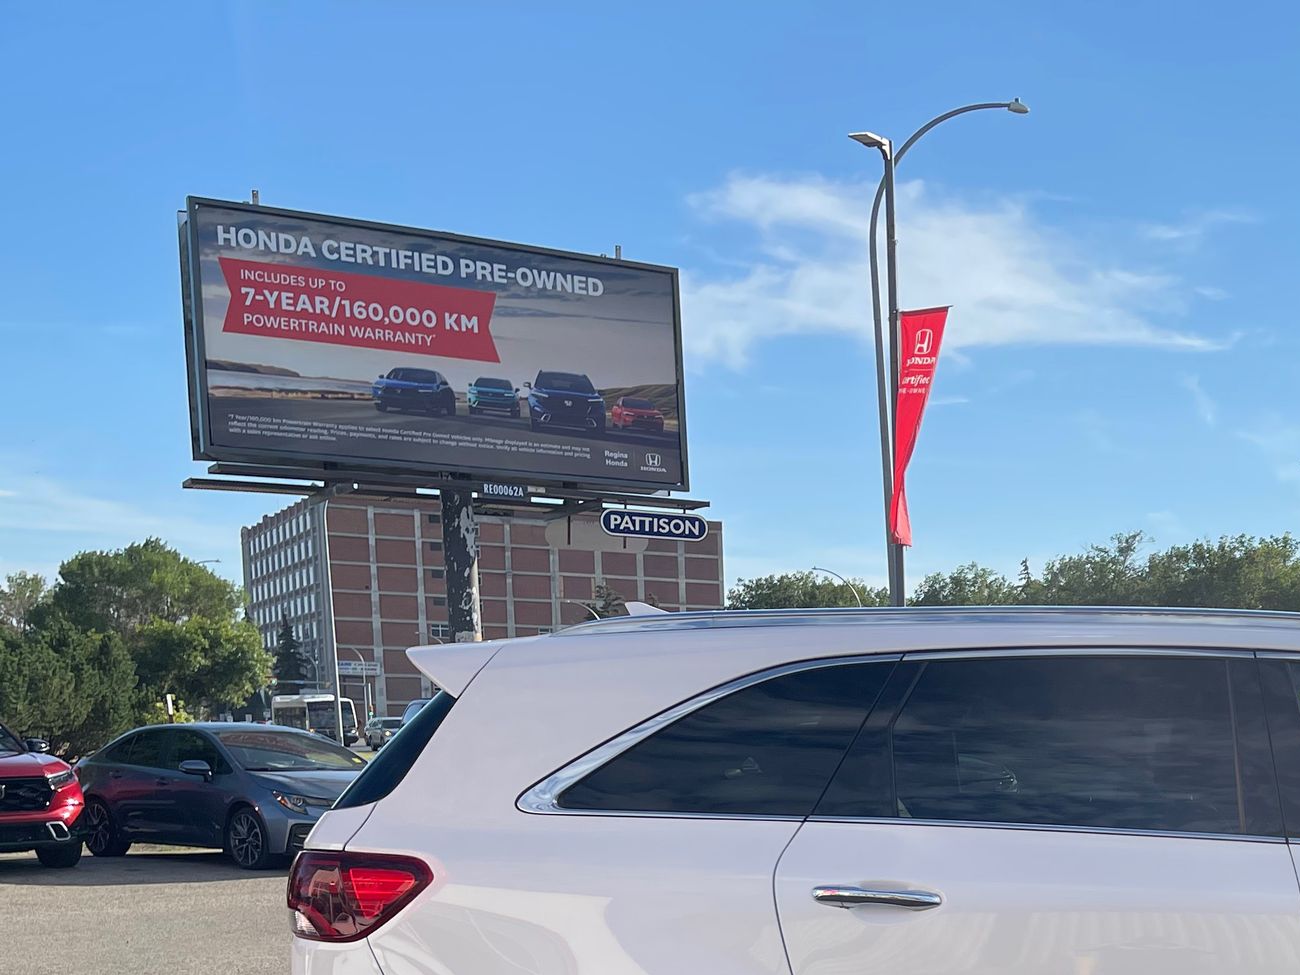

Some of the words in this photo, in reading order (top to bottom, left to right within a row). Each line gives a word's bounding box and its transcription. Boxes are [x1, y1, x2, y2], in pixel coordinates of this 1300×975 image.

[216, 225, 316, 258] HONDA
[321, 239, 454, 276] CERTIFIED
[459, 258, 604, 297] PRE-OWNED
[240, 269, 305, 287] INCLUDES
[308, 278, 325, 289] UP
[329, 280, 346, 292] TO
[240, 287, 437, 328] 7-YEAR/160,000
[444, 312, 479, 334] KM
[243, 313, 345, 336] POWERTRAIN
[604, 450, 628, 459] Regina
[605, 459, 628, 467] Honda
[483, 483, 524, 497] RE00062A
[609, 514, 699, 536] PATTISON
